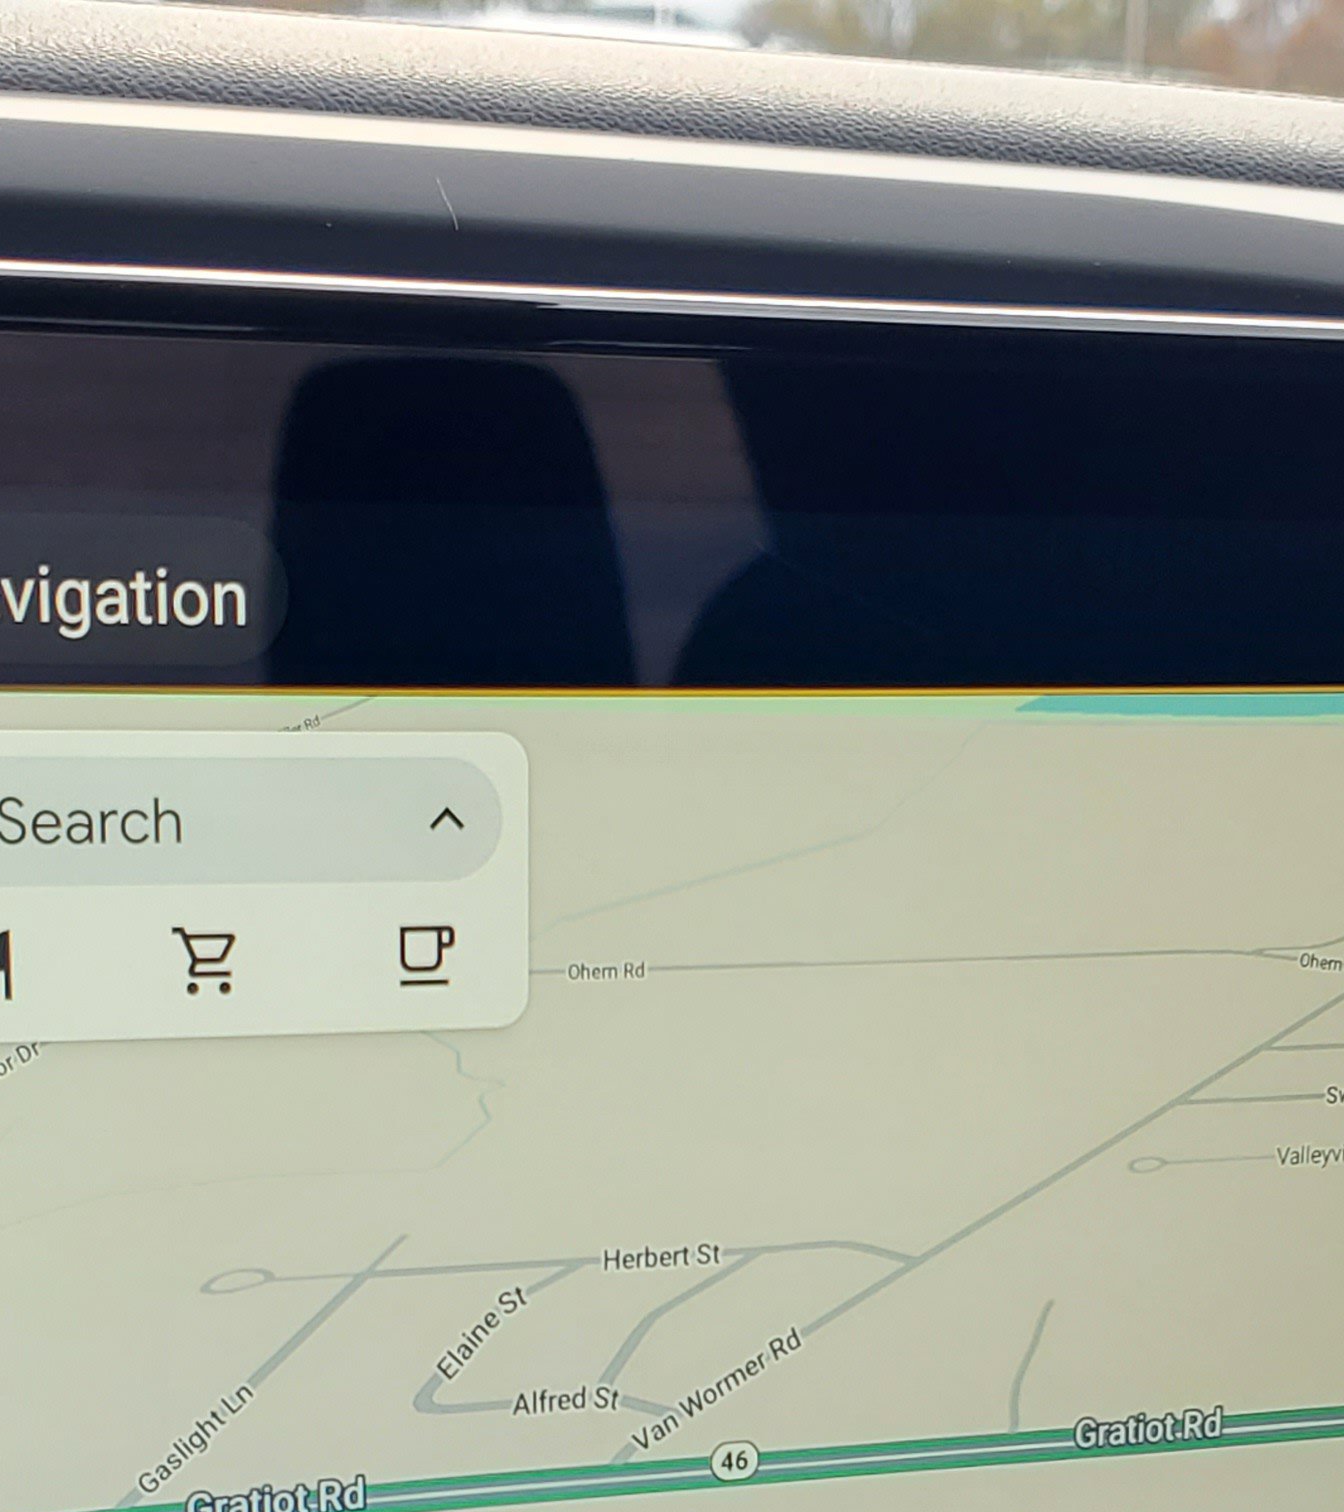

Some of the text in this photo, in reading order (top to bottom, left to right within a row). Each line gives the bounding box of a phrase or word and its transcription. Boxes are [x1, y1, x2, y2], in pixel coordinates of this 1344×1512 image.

[624, 961, 645, 979] Rd
[15, 1042, 42, 1066] Dr
[602, 1242, 721, 1271] Herbert St
[435, 1285, 528, 1381] Elaine St
[512, 1386, 619, 1415] Alfred St
[631, 1327, 802, 1450] Van Wormer Rd
[137, 1384, 255, 1495] Gaslight Ln
[1073, 1405, 1223, 1449] Gratiot Rd
[721, 1450, 749, 1471] 46
